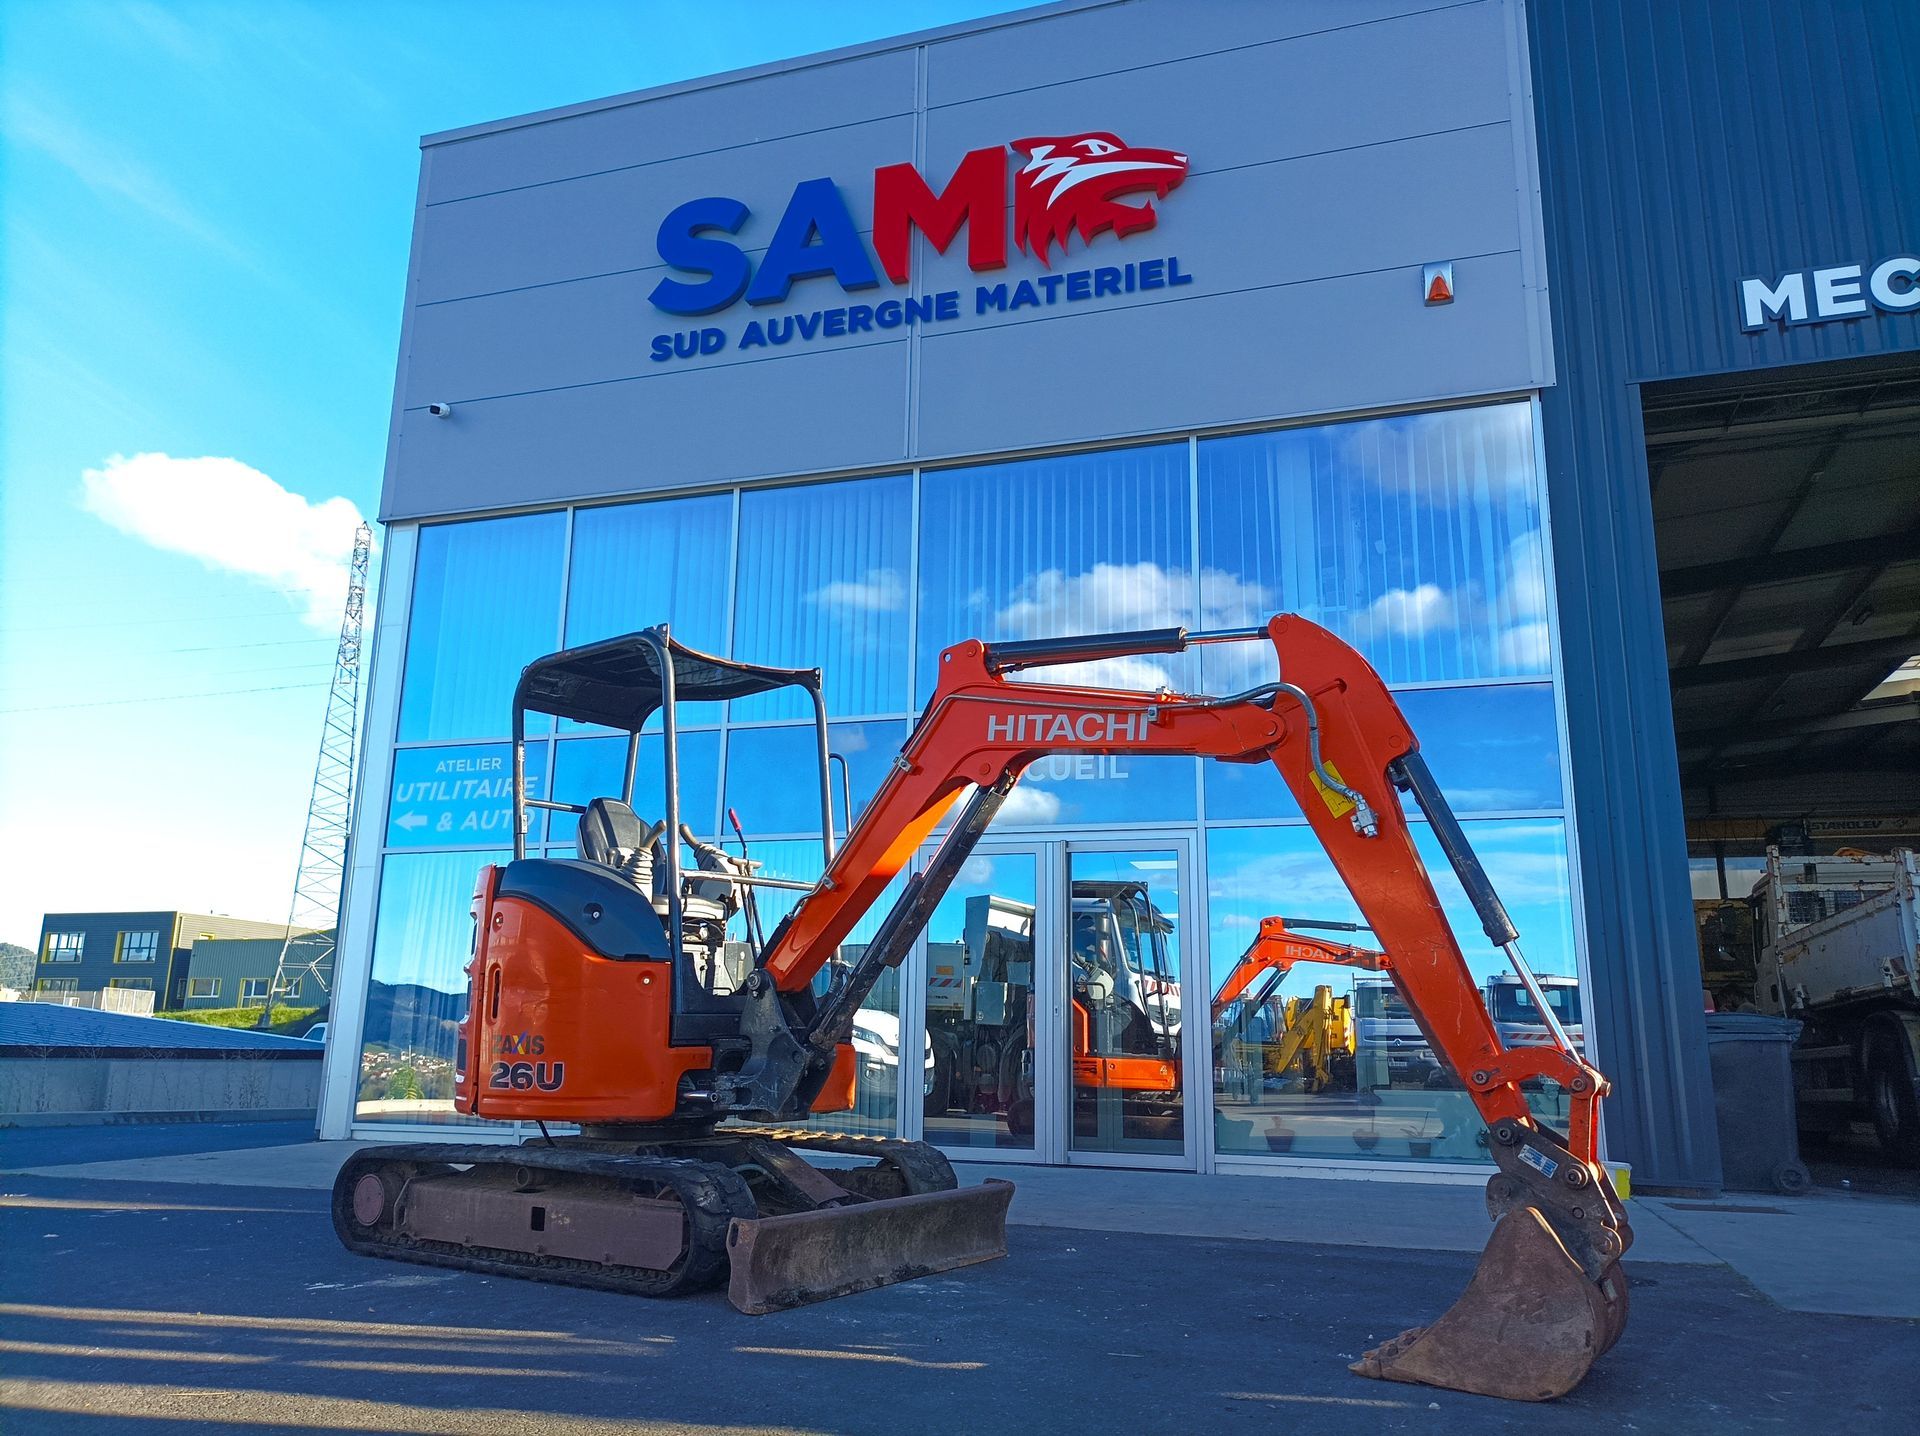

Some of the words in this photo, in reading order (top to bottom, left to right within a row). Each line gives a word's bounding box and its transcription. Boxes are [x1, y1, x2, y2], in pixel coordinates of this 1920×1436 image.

[648, 145, 1007, 317] SAM
[1742, 257, 1920, 327] MEC
[650, 327, 725, 362] SUD
[738, 291, 960, 349] AUVERGNE
[976, 257, 1192, 314] MATERIEL
[987, 713, 1148, 742] HITACHI
[435, 757, 502, 773] ATELIER
[436, 812, 454, 832] &
[489, 1061, 564, 1092] 26U
